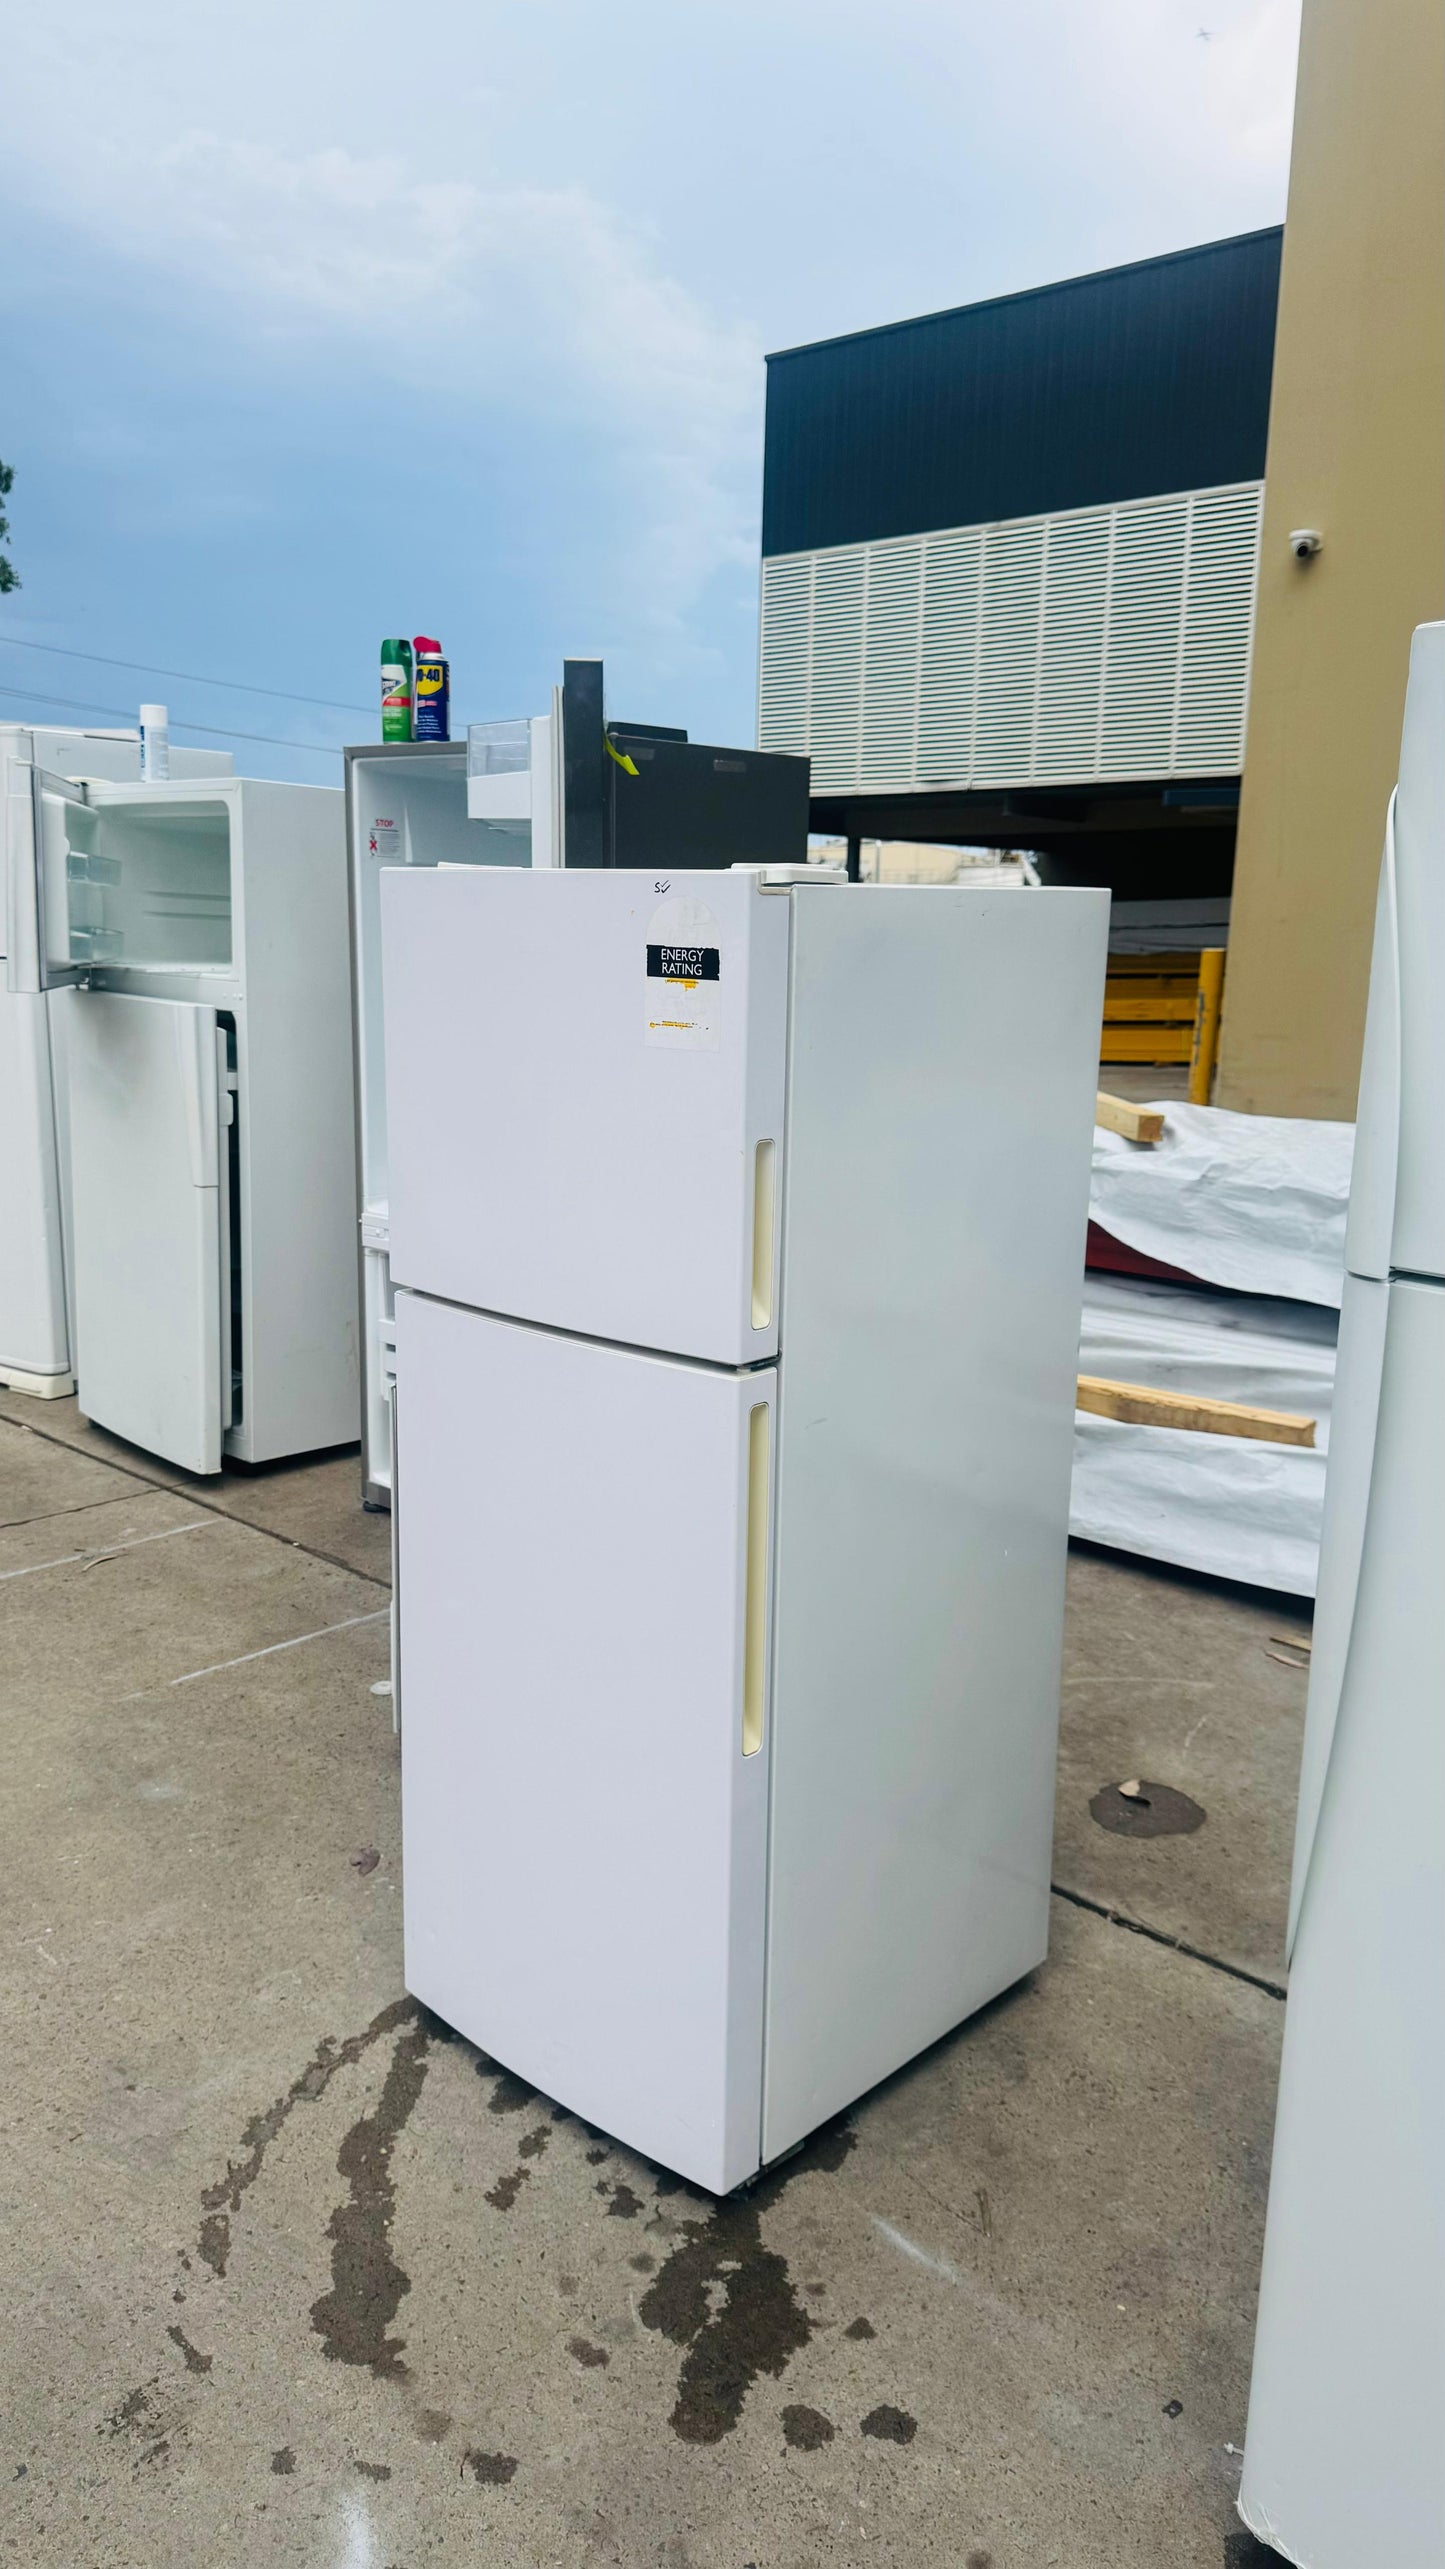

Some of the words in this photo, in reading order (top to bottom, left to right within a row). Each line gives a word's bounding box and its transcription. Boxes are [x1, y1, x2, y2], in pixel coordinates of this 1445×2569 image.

[416, 668, 440, 682] D-40
[375, 819, 394, 827] STOP
[661, 948, 704, 962] ENERGY
[661, 962, 702, 976] RATING
